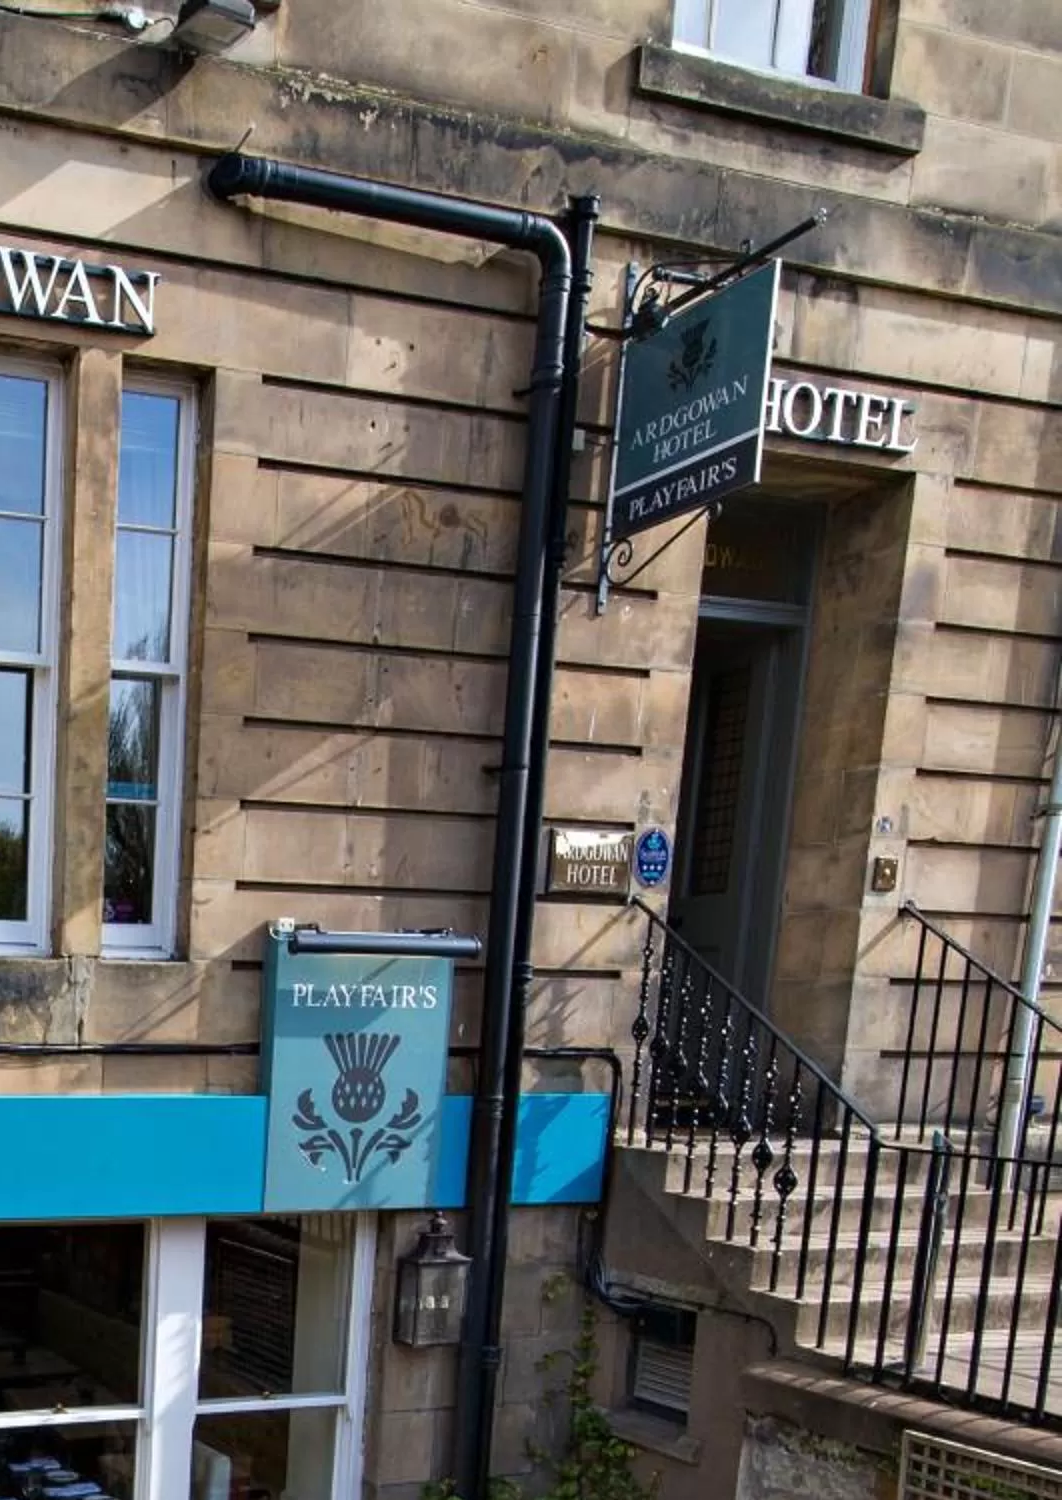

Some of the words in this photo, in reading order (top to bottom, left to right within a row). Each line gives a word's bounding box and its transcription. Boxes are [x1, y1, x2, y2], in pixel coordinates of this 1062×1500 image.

[630, 374, 750, 450] ARDGOWAN
[765, 378, 919, 449] HOTEL
[652, 419, 717, 464] HOTEL
[628, 457, 738, 521] PLAYFAIR'S
[566, 863, 618, 885] HOTEL
[292, 983, 438, 1009] PLAYFAIR'S
